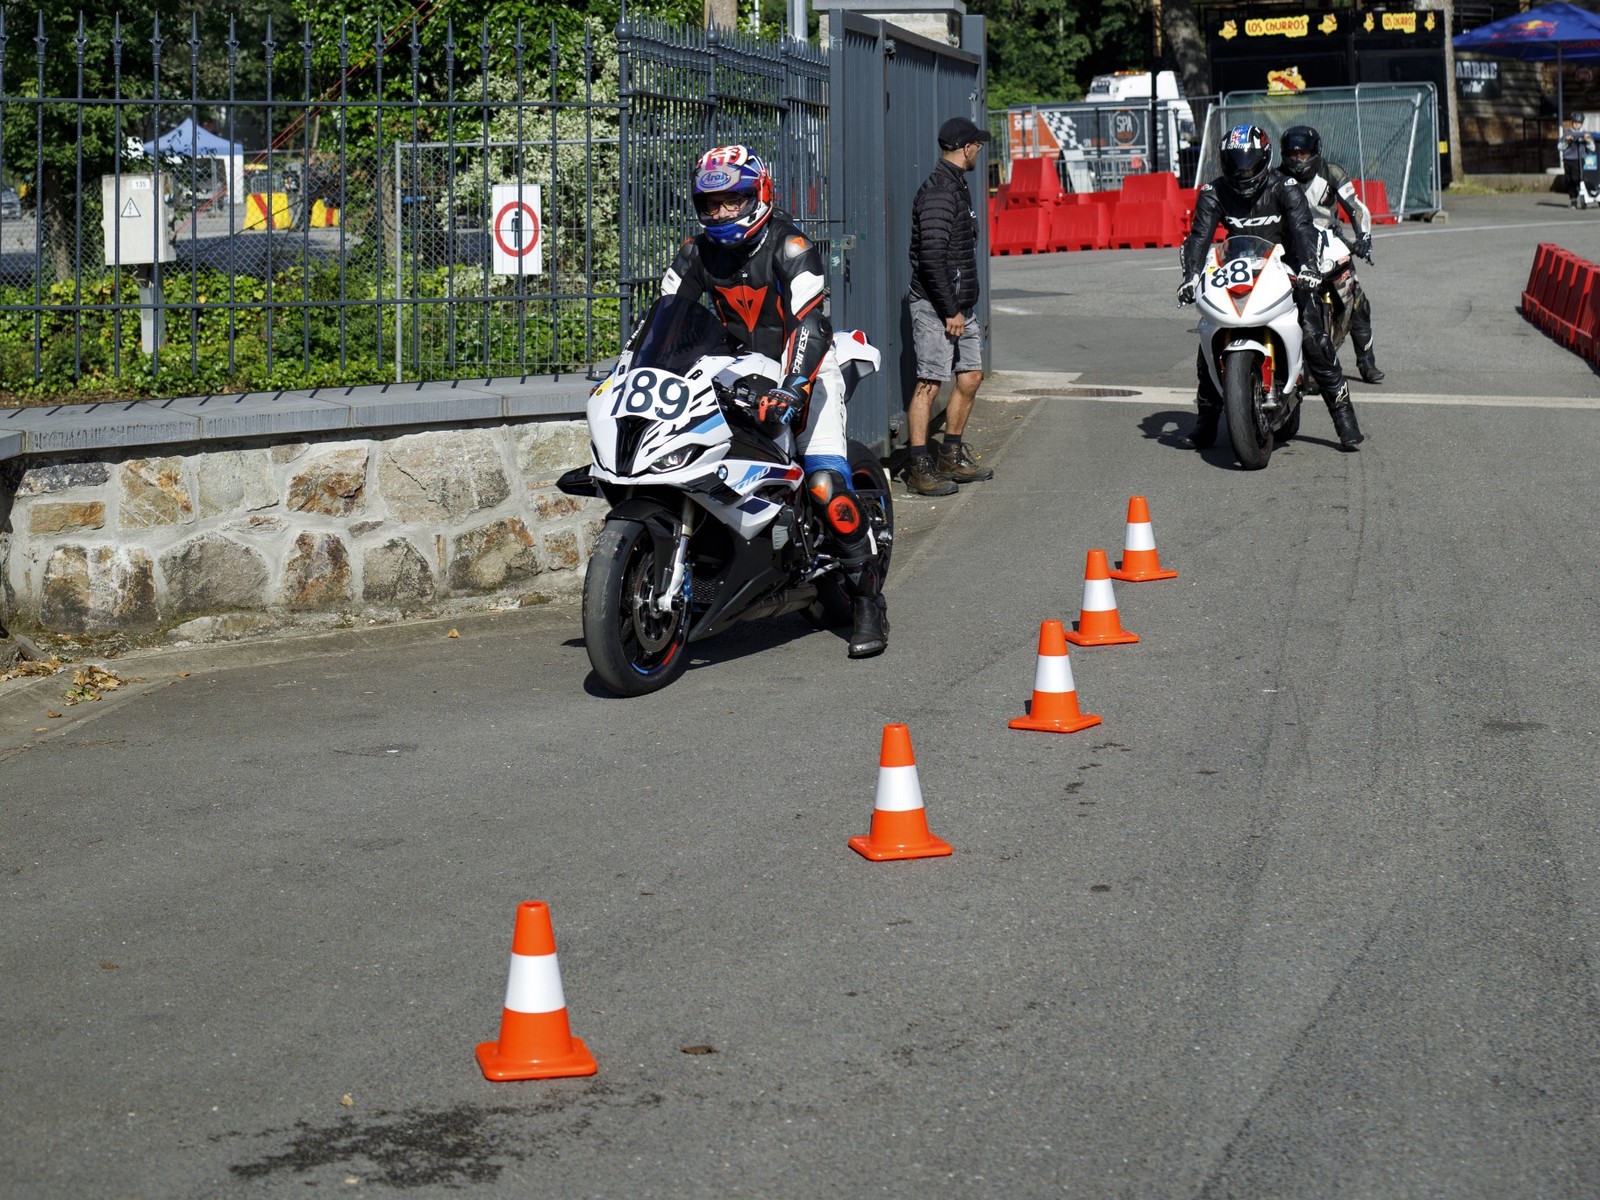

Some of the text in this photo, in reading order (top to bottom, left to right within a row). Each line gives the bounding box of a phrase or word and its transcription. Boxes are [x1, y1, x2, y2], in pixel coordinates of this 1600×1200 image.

[1247, 21, 1263, 33] LOS
[1116, 115, 1133, 132] SPA
[610, 370, 690, 420] 189
